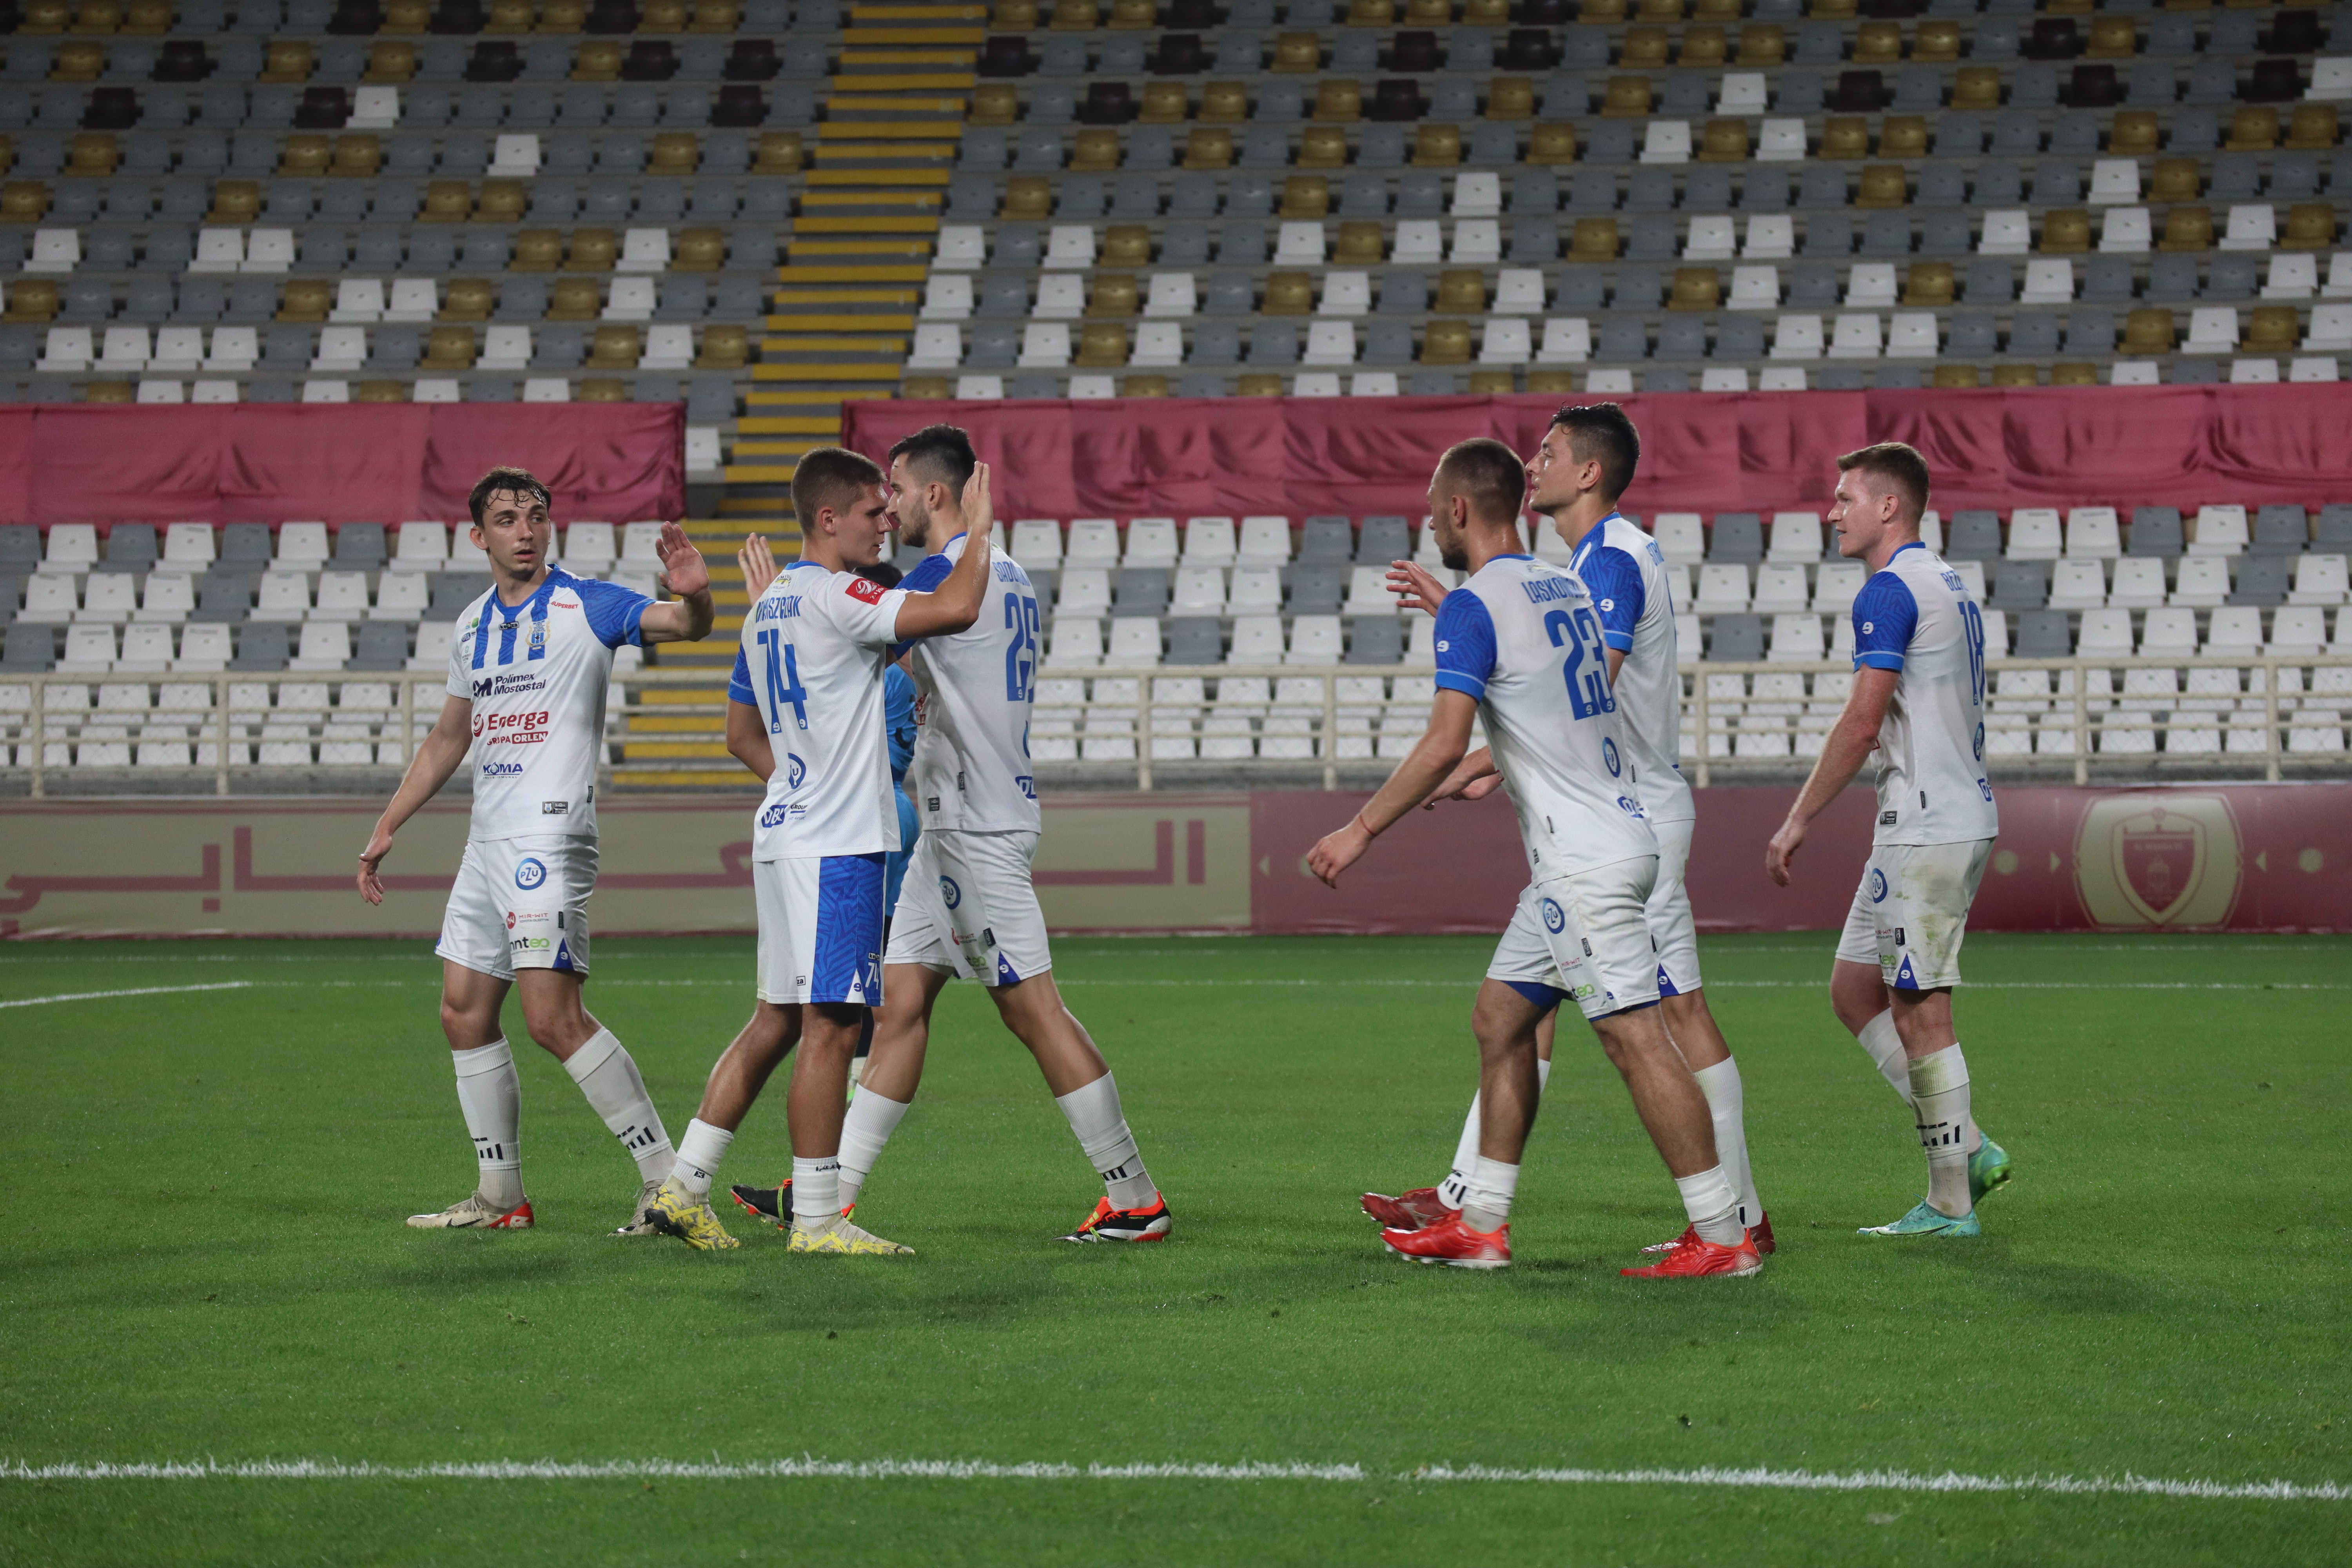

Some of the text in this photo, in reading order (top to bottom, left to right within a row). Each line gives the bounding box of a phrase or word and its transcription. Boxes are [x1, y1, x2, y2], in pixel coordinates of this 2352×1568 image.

[1005, 593, 1040, 703] 25
[1957, 601, 1985, 706] 18
[1544, 608, 1615, 720] 23
[494, 679, 546, 695] Mostostal
[495, 673, 535, 685] Polimex
[757, 629, 808, 734] 74
[488, 711, 548, 730] Energa
[514, 733, 547, 743] ORLEN
[483, 762, 523, 775] KOMA
[520, 867, 538, 881] PZU
[1546, 908, 1558, 924] PZU
[865, 962, 879, 990] 74
